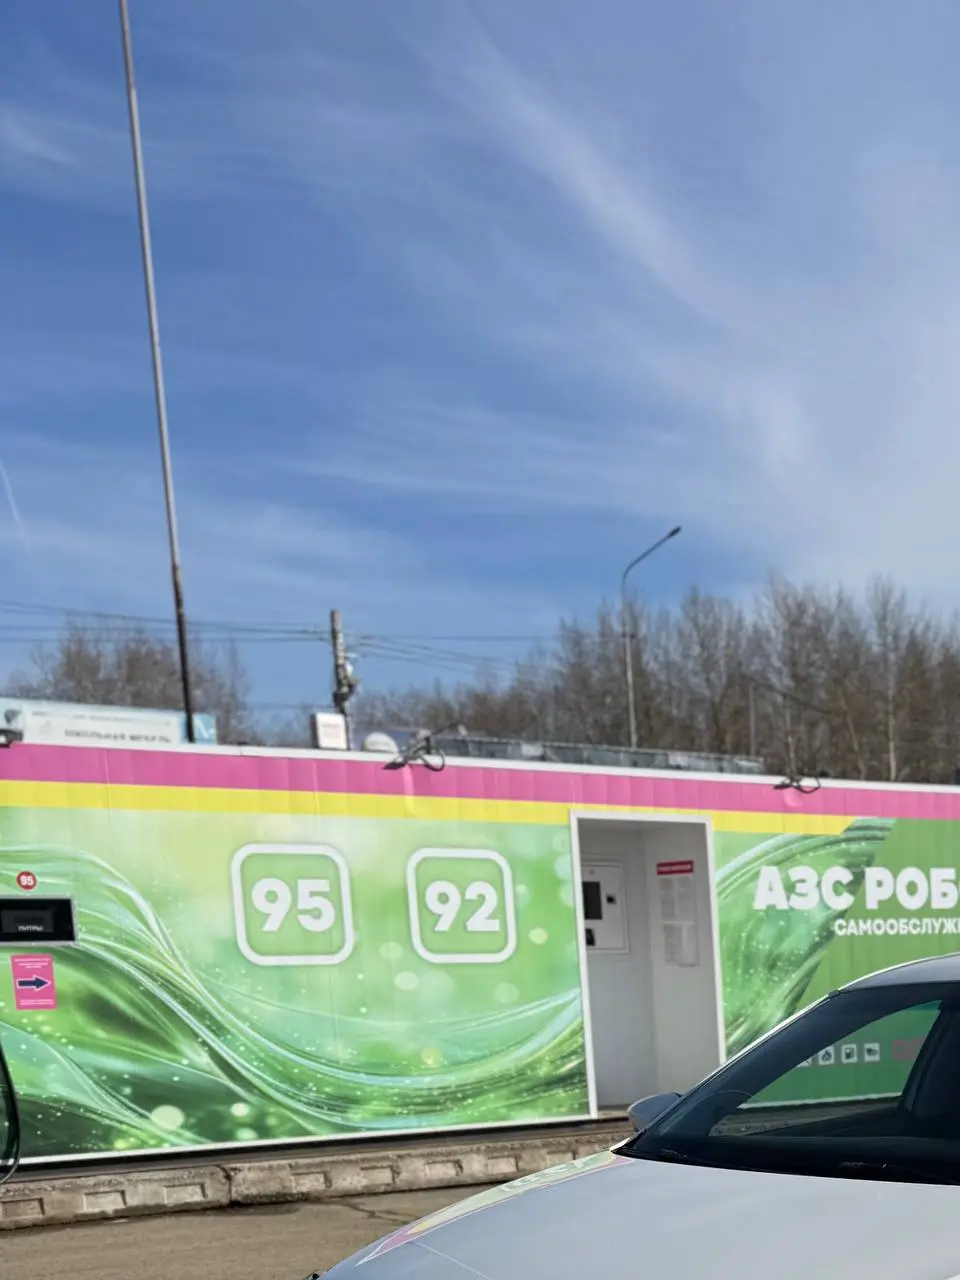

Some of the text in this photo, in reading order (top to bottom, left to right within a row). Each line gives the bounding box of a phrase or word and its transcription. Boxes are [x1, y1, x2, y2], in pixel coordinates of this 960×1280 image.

[19, 875, 34, 886] 95
[251, 877, 336, 932] 95
[753, 865, 855, 911] АЗС
[424, 880, 500, 932] 92
